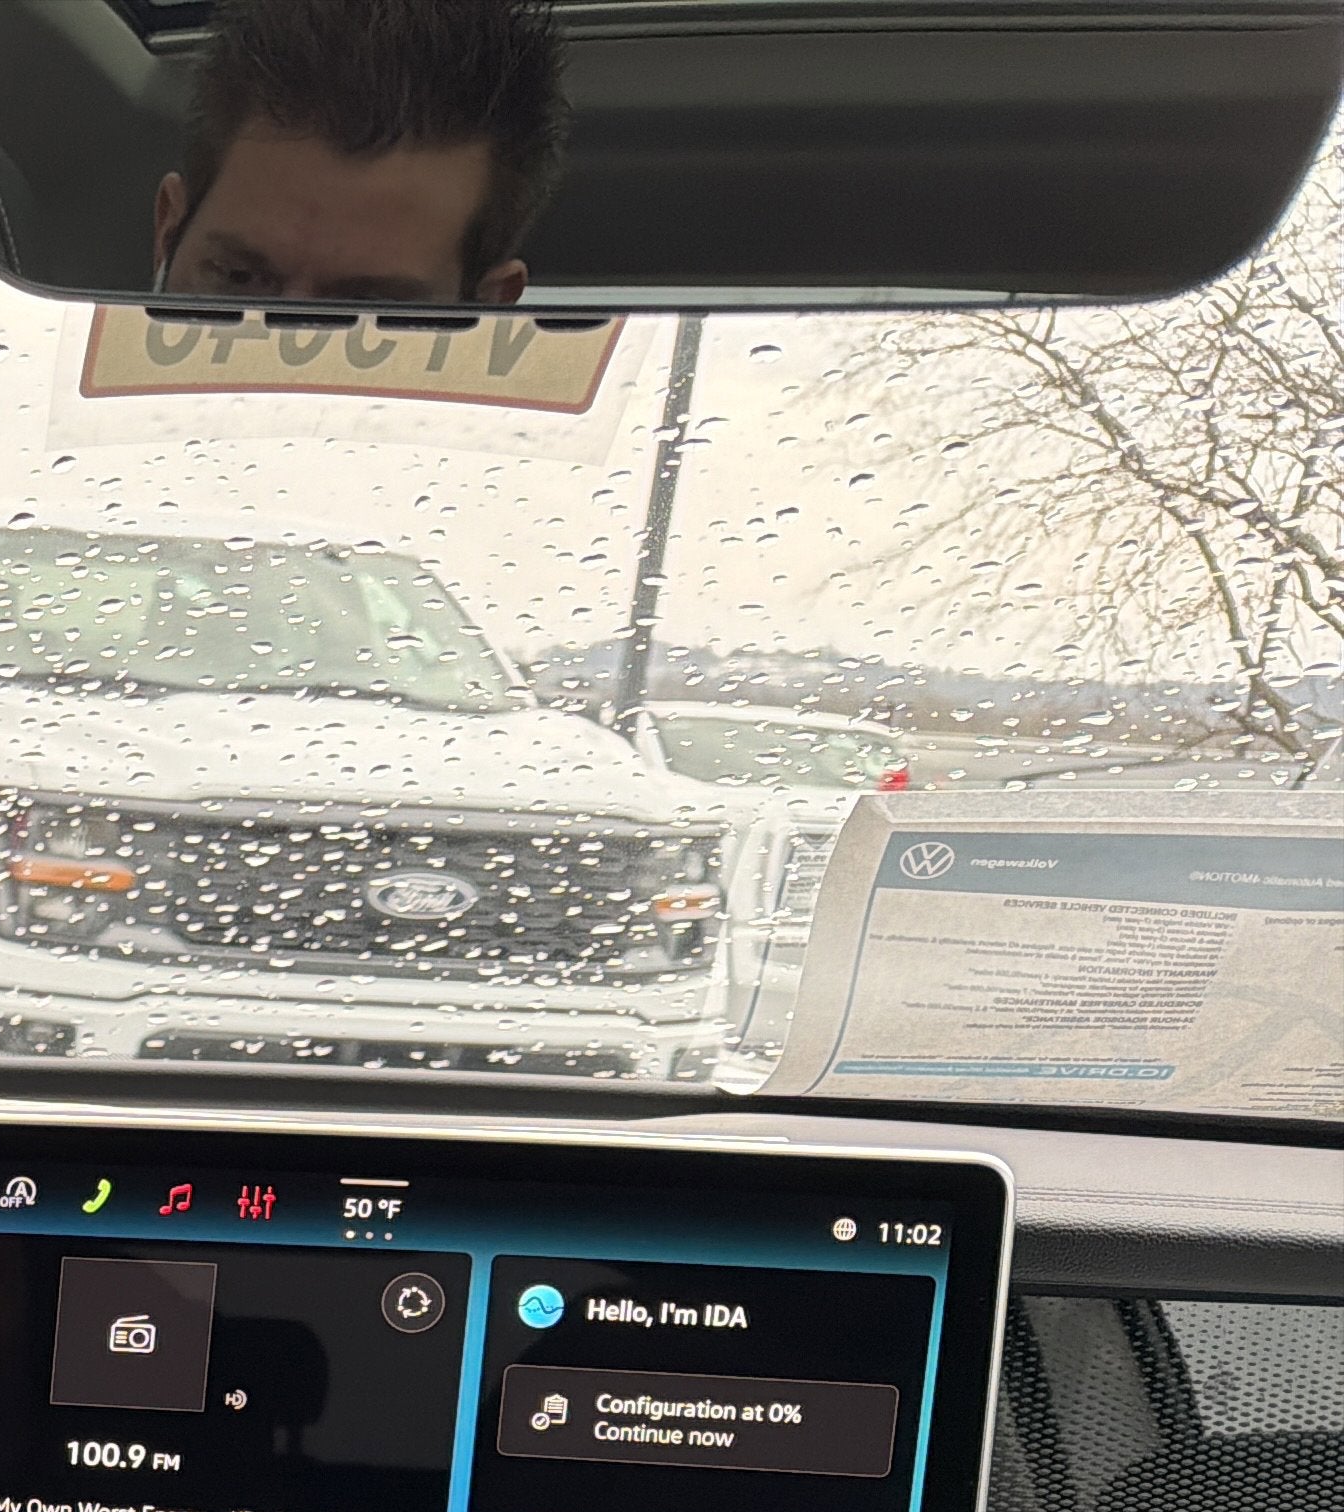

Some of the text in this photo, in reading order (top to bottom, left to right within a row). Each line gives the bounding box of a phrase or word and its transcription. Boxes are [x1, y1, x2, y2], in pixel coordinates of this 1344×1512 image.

[343, 1197, 372, 1218] 50
[878, 1222, 943, 1246] 11:02
[587, 1298, 748, 1329] Hello, I'm IDA
[595, 1393, 802, 1425] Configuration at 0%
[593, 1422, 734, 1448] Continue now
[66, 1440, 181, 1472] 100.9 FM
